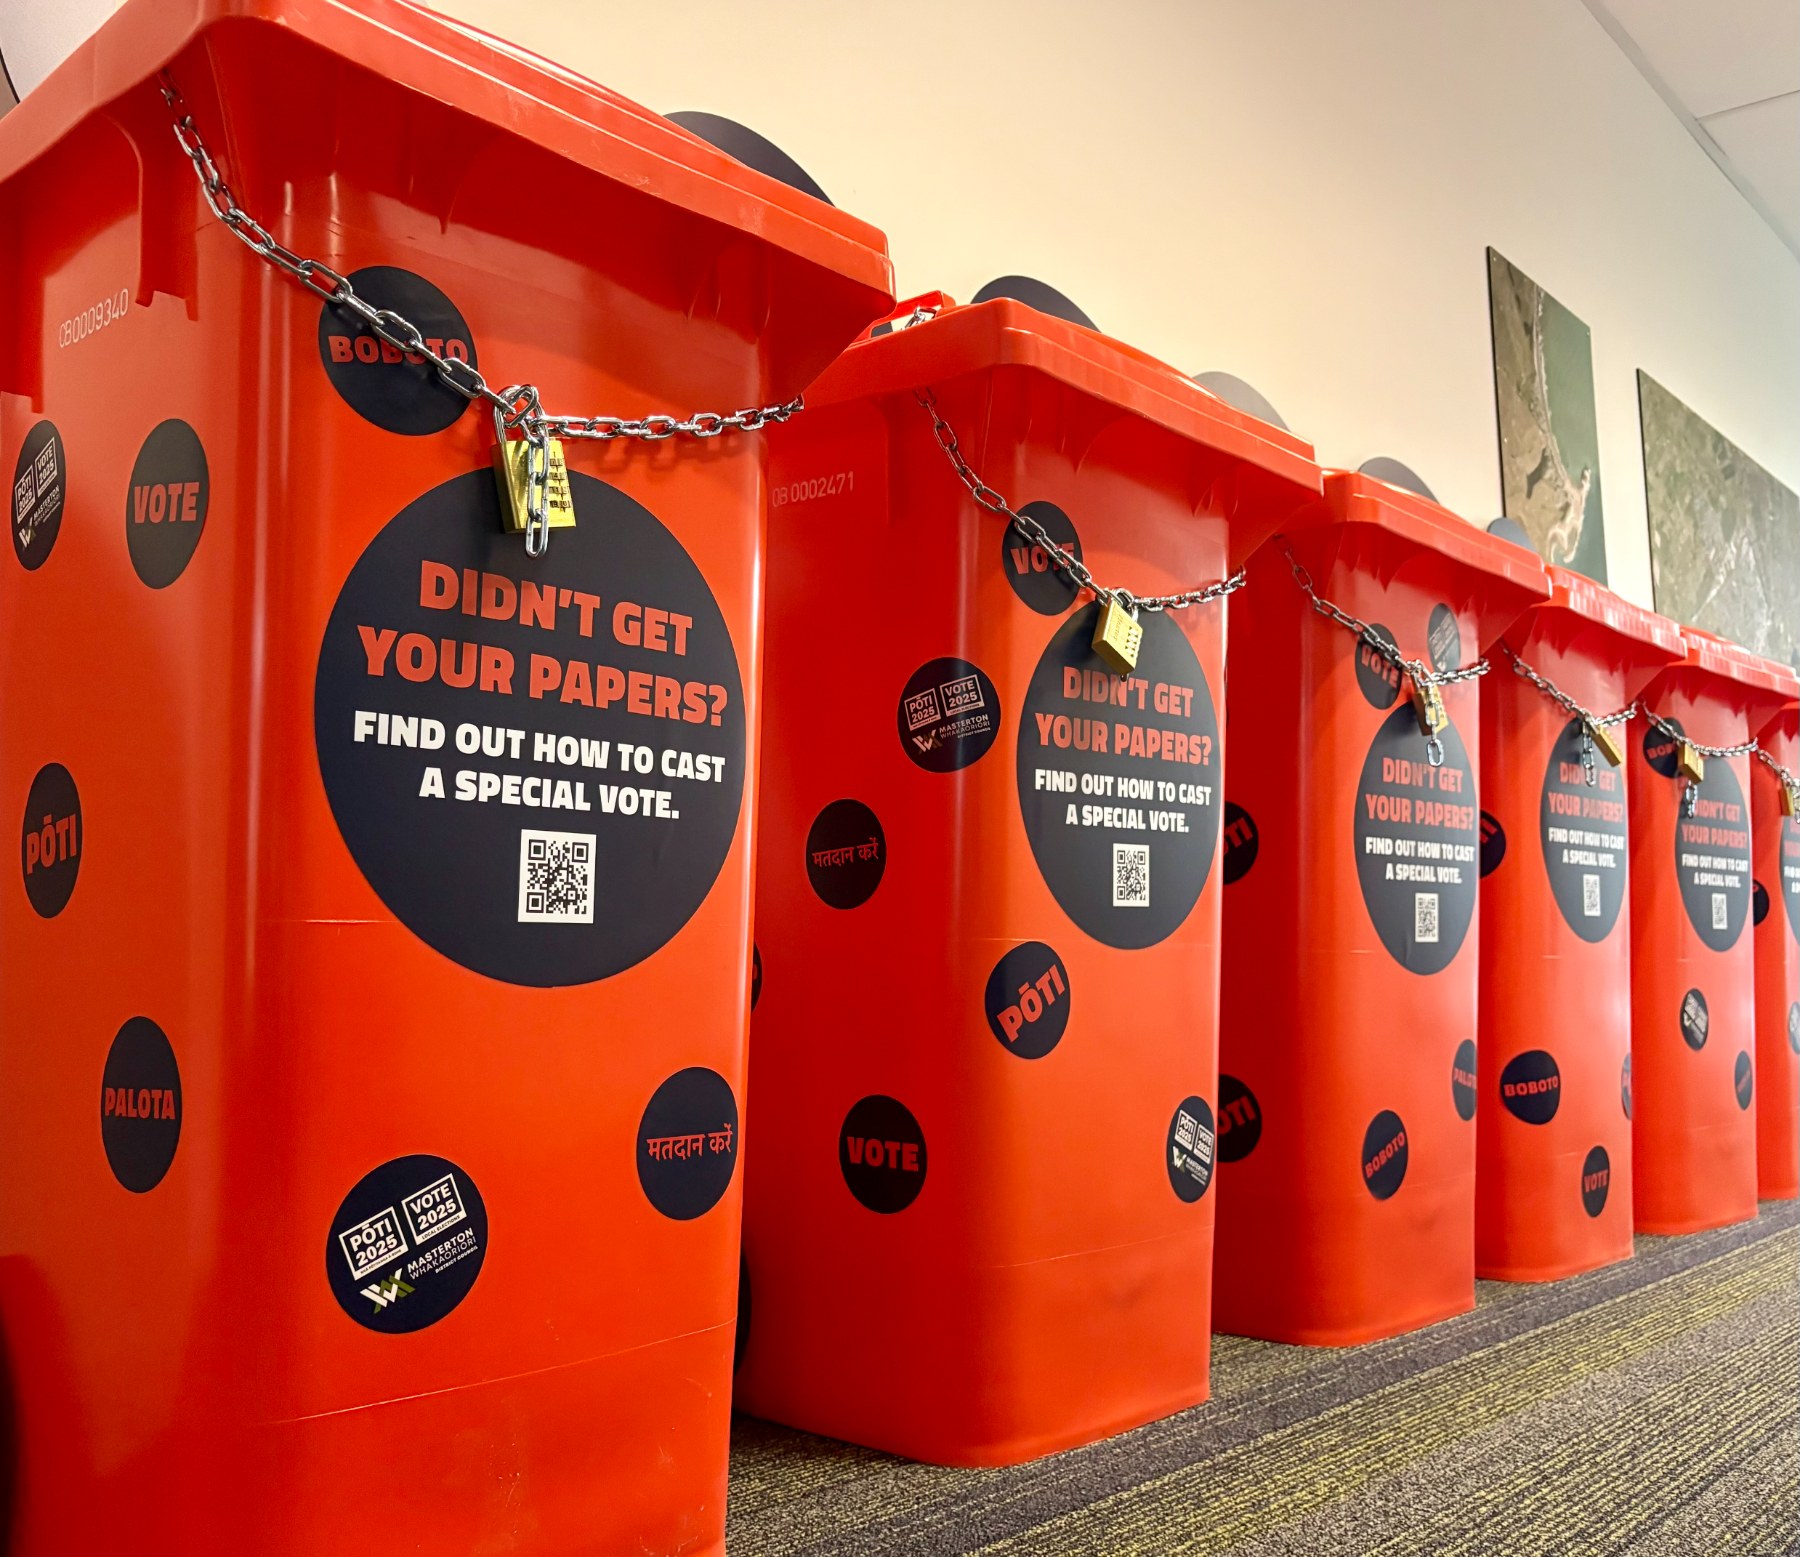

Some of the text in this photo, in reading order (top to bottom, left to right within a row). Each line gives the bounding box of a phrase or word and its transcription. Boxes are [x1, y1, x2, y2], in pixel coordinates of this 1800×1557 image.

[37, 444, 53, 471] VOTE
[38, 459, 55, 485] 2025
[17, 477, 32, 498] PŌTI
[18, 489, 33, 513] 2025
[133, 481, 200, 524] VOTE
[791, 471, 854, 502] 0002471
[419, 560, 693, 656] DIDN'T GET
[357, 624, 728, 727] YOUR PAPERS?
[944, 680, 976, 697] VOTE
[948, 691, 978, 708] 2025
[1063, 666, 1194, 718] DIDN'T GET
[911, 706, 936, 723] 2025
[939, 714, 989, 734] MASTERTON
[353, 710, 726, 782] FIND OUT HOW TO CAST
[1035, 712, 1212, 766] YOUR PAPERS?
[1035, 768, 1212, 806] FIND OUT HOW TO CAST
[1382, 757, 1463, 793] DIDN'T GET
[419, 766, 680, 819] A SPECIAL VOTE.
[1548, 791, 1581, 817] YOUR
[1065, 804, 1190, 833] A SPECIAL VOTE.
[1365, 793, 1411, 823] YOUR
[1415, 799, 1474, 831] PAPERS?
[26, 813, 78, 875] PŌTI
[1365, 836, 1475, 862] FIND OUT HOW TO CAST
[1548, 827, 1568, 843] FIND
[1569, 829, 1584, 845] OUT
[812, 837, 879, 868] मतदान करें
[1385, 863, 1462, 884] A SPECIAL VOTE.
[996, 964, 1066, 1043] PŌTI
[1503, 1075, 1559, 1097] BOBOTO
[104, 1086, 176, 1120] PALOTA
[647, 1122, 733, 1161] मतदान करें
[846, 1136, 919, 1172] VOTE
[1365, 1131, 1405, 1178] BOBOTO
[1583, 1169, 1608, 1193] VOTE
[409, 1183, 452, 1214] VOTE
[417, 1198, 457, 1230] 2025
[349, 1217, 393, 1252] PŌTI
[356, 1234, 398, 1267] 2025
[407, 1227, 474, 1273] MASTERTON
[421, 1229, 437, 1240] LOCAL
[410, 1236, 477, 1280] WHAKAORIORI
